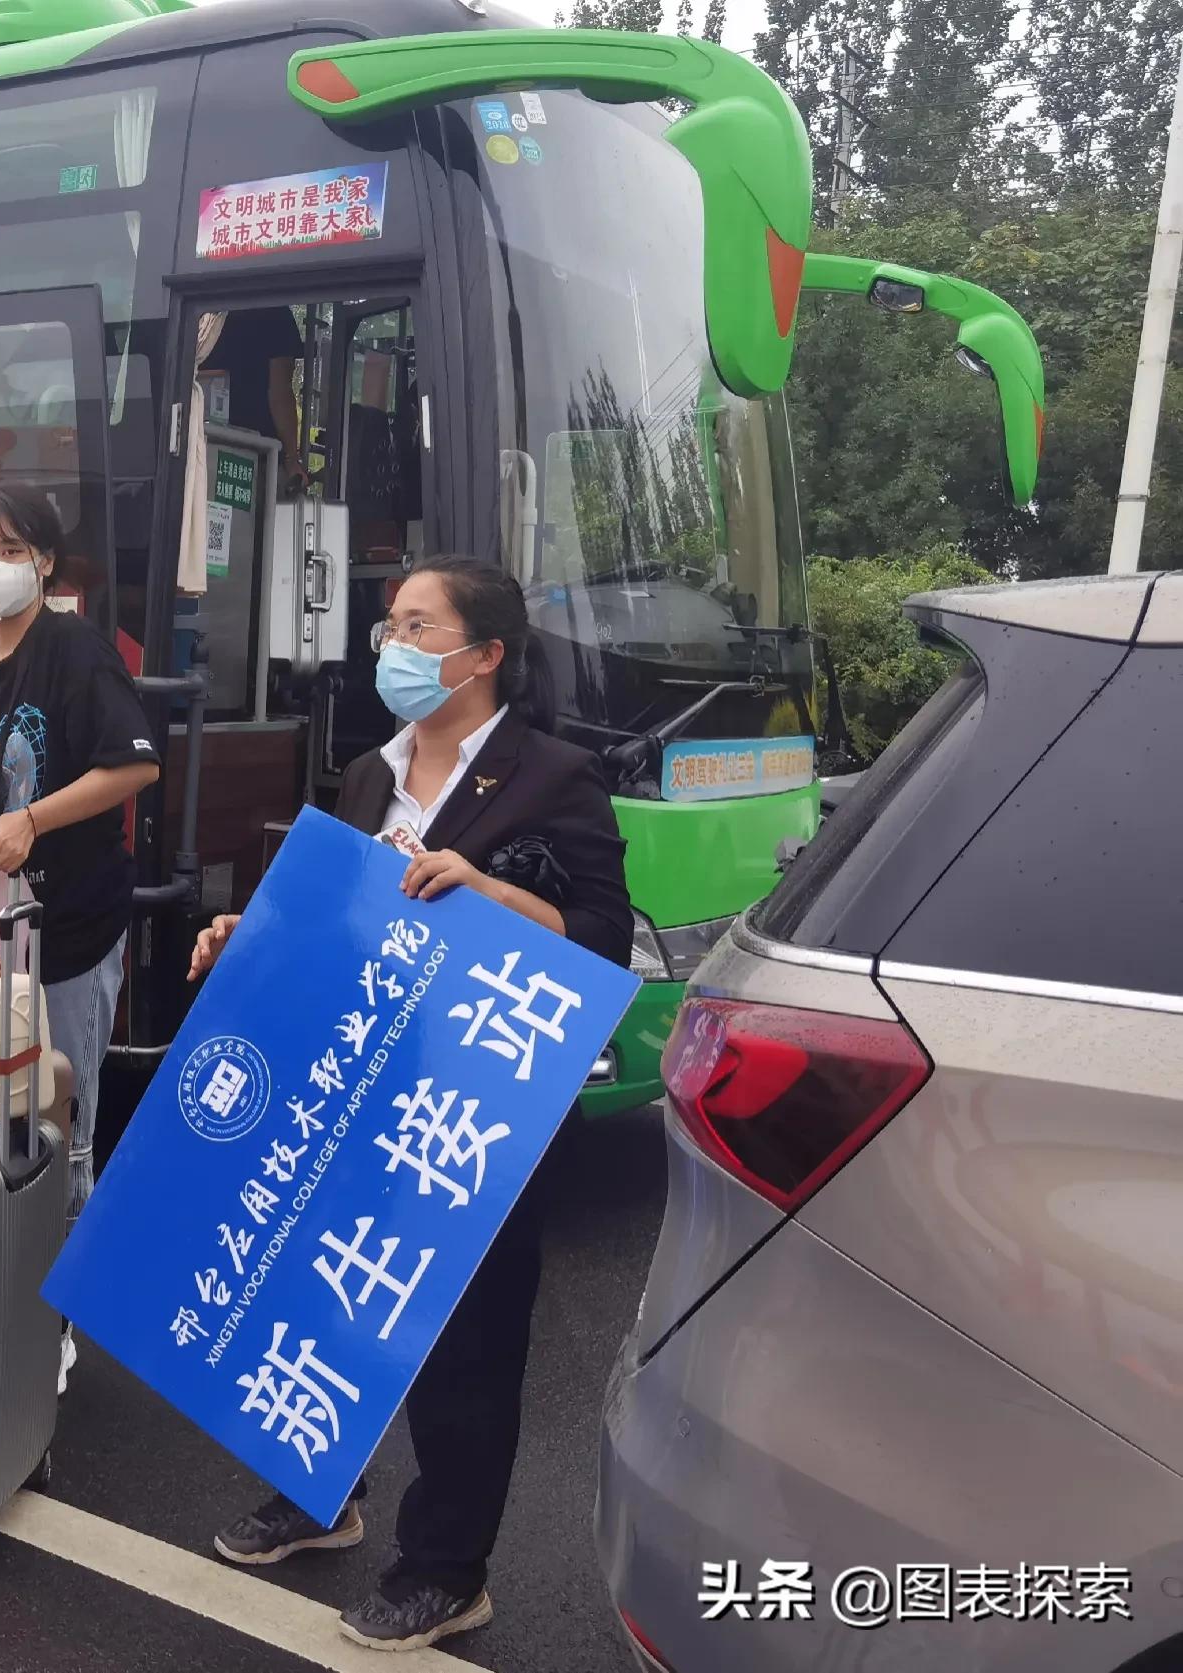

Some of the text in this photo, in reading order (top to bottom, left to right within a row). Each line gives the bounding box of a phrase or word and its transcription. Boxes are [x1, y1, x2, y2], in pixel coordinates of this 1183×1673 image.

[212, 205, 364, 247] 城市文明靠大家
[214, 177, 368, 221] 文明城市是我家
[205, 938, 450, 1369] XINGTAI VOCATIONAL COLLEGE OF APPLIED TECHNOLOGY
[236, 951, 582, 1474] 新生接站
